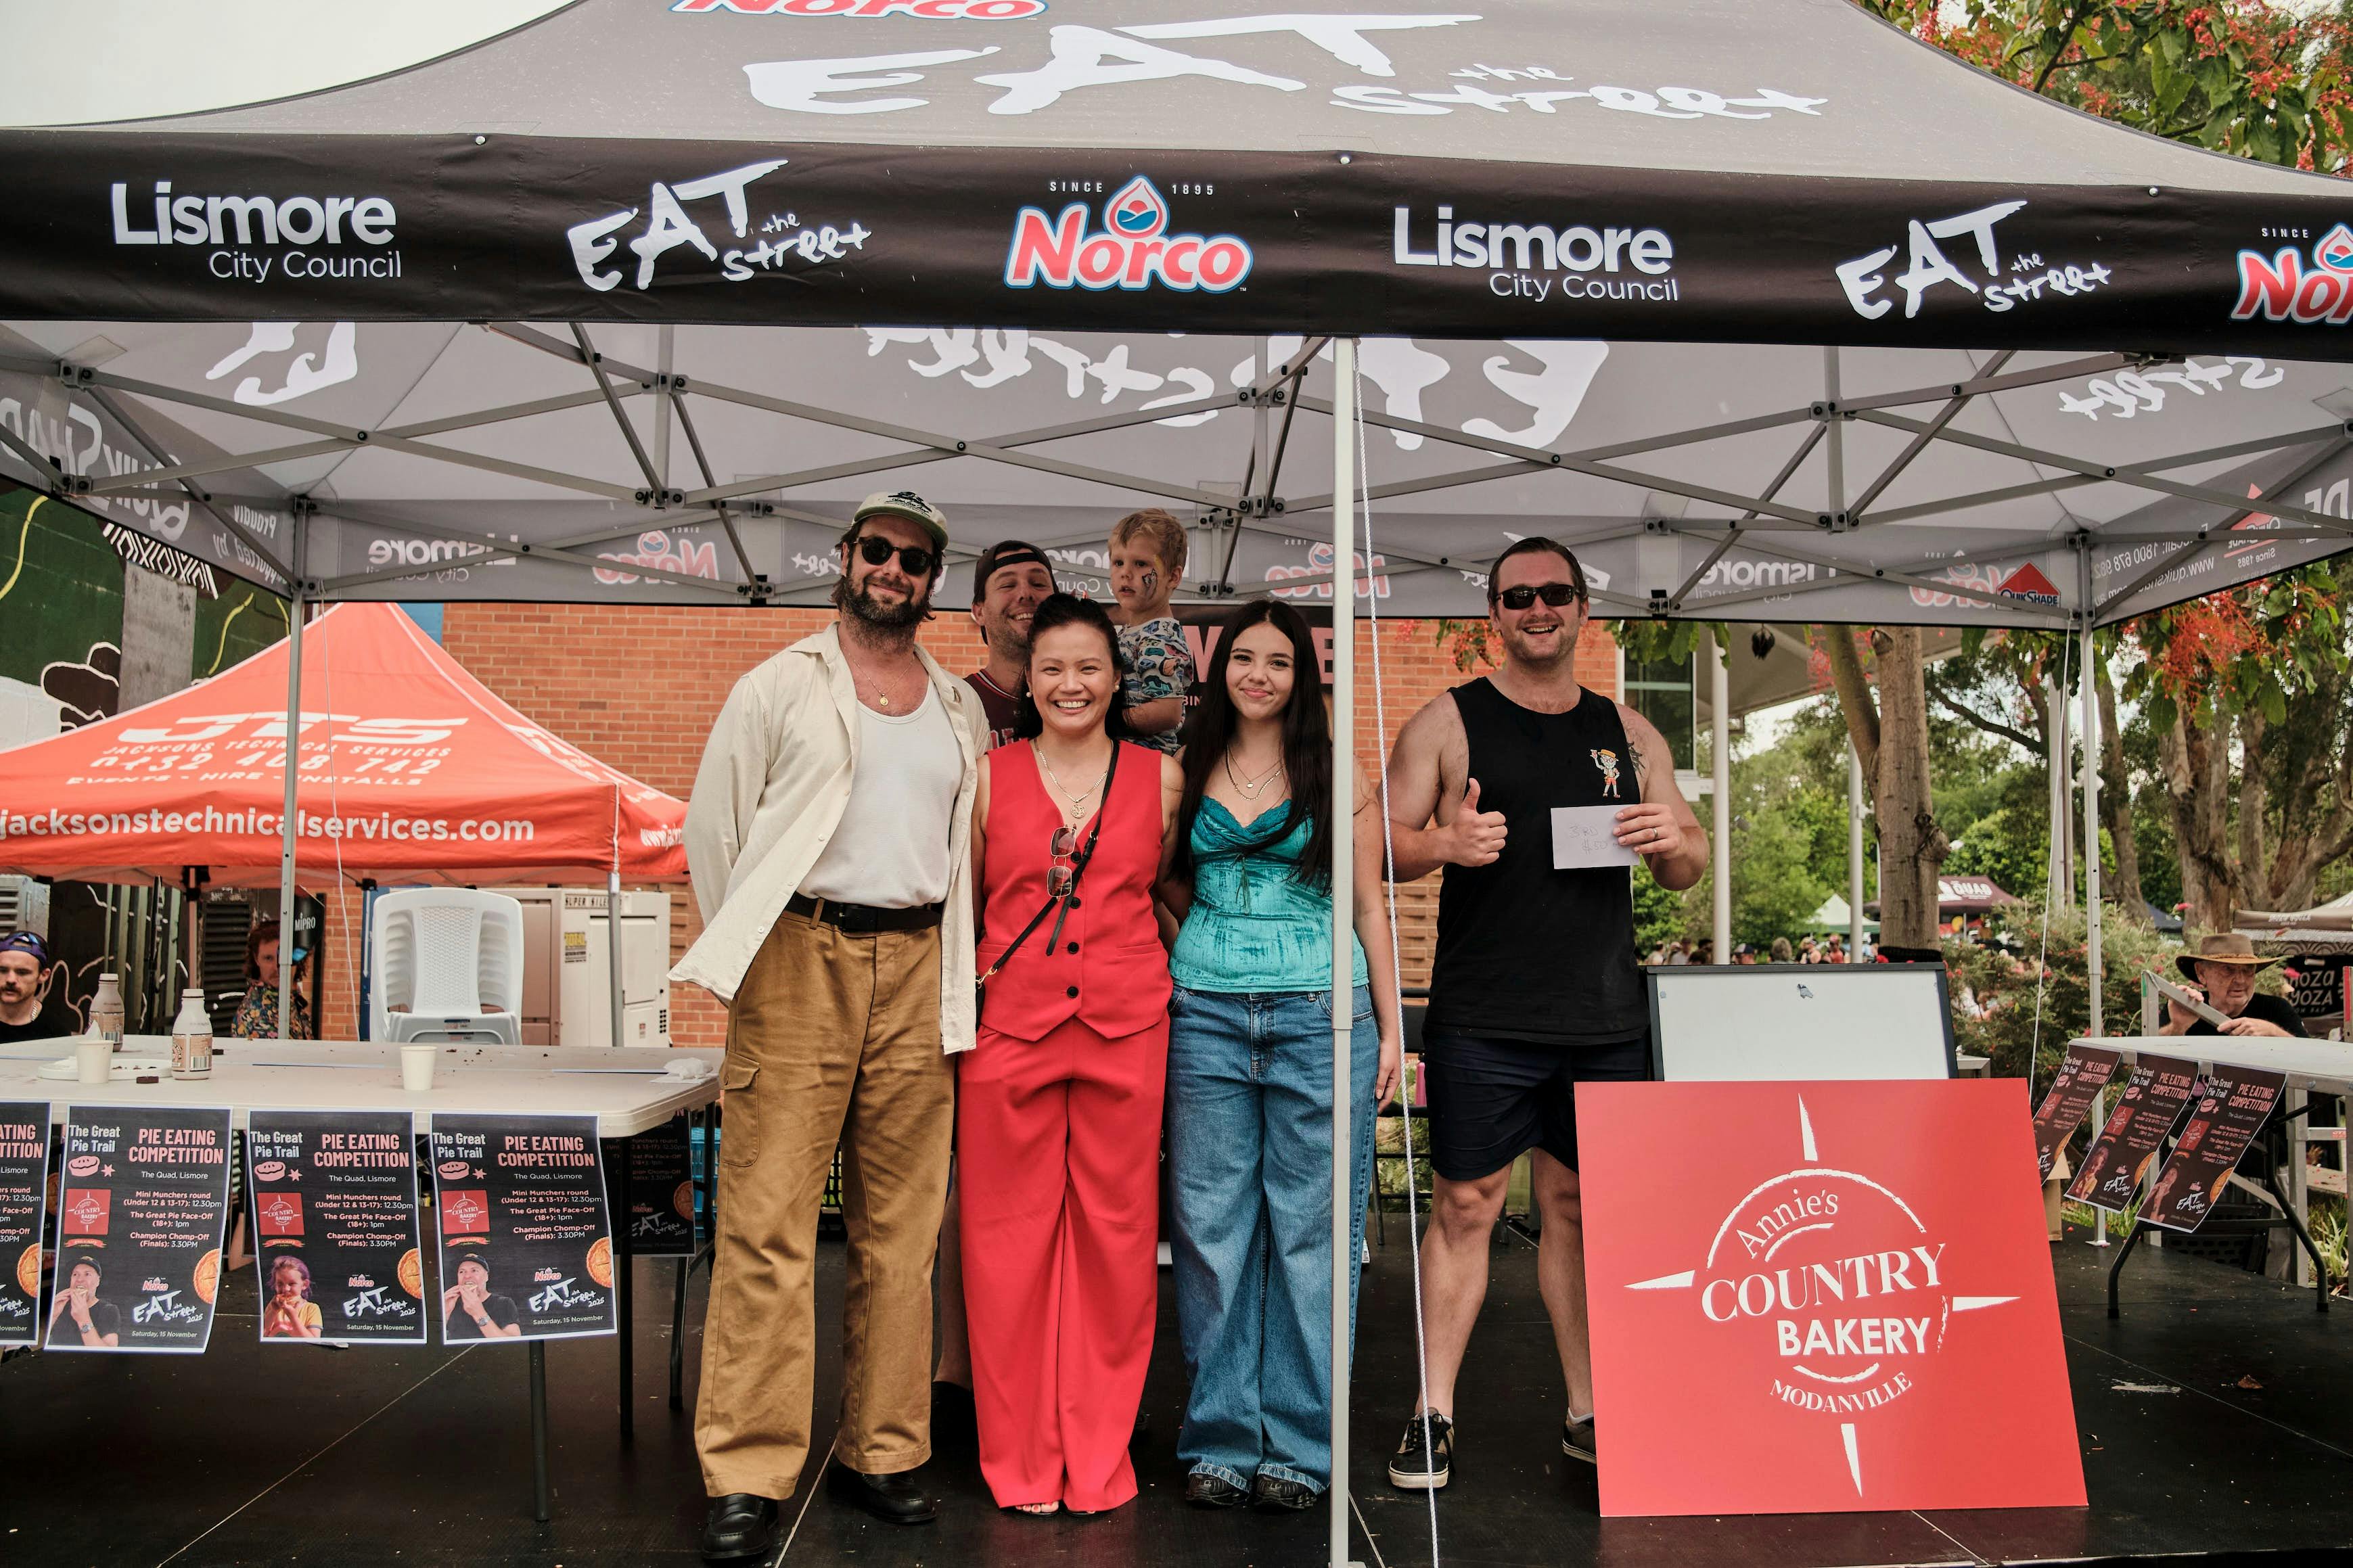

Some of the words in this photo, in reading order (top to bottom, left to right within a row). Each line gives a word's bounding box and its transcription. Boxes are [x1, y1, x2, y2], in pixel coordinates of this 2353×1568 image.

[741, 14, 1484, 115] EAT
[1448, 63, 1574, 81] the
[1329, 84, 1828, 120] street
[1049, 181, 1103, 193] SINCE
[1172, 183, 1214, 196] 1895
[111, 180, 396, 245] Lismore
[567, 159, 788, 291] EAT
[761, 212, 801, 234] the
[1394, 205, 1673, 274] Lismore
[2261, 227, 2309, 238] SINCE
[723, 225, 871, 281] street
[1005, 203, 1253, 292] Norco
[209, 251, 272, 283] City
[282, 250, 401, 279] Council
[1835, 201, 2027, 320] EAT
[2011, 252, 2044, 273] the
[1489, 273, 1551, 302] City
[1562, 274, 1678, 302] Council
[1984, 263, 2111, 312] street
[118, 712, 468, 744] JTS
[102, 742, 214, 755] JACKSONS
[350, 745, 451, 758] SERVICES
[355, 758, 442, 775] 742
[200, 772, 264, 780] HIRE
[295, 913, 315, 931] MIPRO
[2160, 1073, 2172, 1084] PIE
[2172, 1075, 2191, 1087] EATING
[2220, 1079, 2232, 1088] Great
[2151, 1084, 2190, 1099] COMPETITION
[2207, 1088, 2216, 1096] Pie
[2238, 1084, 2250, 1095] PIE
[2252, 1086, 2274, 1099] EATING
[2229, 1096, 2273, 1111] COMPETITION
[68, 1125, 88, 1137] The
[91, 1125, 120, 1138] Great
[139, 1128, 162, 1145] PIE
[165, 1129, 216, 1145] EATING
[250, 1131, 271, 1143] The
[273, 1131, 303, 1143] Great
[433, 1132, 453, 1145] The
[455, 1133, 486, 1145] Great
[71, 1140, 89, 1151] Pie
[92, 1140, 116, 1152] Trail
[321, 1134, 344, 1149] PIE
[348, 1134, 400, 1150] EATING
[505, 1136, 528, 1151] PIE
[532, 1136, 584, 1151] EATING
[129, 1147, 224, 1163] COMPETITION
[255, 1146, 272, 1157] Pie
[274, 1146, 300, 1158] Trail
[314, 1152, 409, 1168] COMPETITION
[438, 1147, 455, 1157] Pie
[457, 1147, 483, 1158] Trail
[497, 1153, 595, 1167] COMPETITION
[153, 1191, 187, 1199] Munchers
[2176, 1192, 2203, 1210] EAT
[192, 1200, 222, 1208] 12.30pm
[513, 1226, 552, 1235] Champion
[553, 1224, 595, 1232] Chomp-Off
[1737, 1189, 1839, 1258] Annie's
[534, 1271, 562, 1282] Norco
[1701, 1243, 1946, 1322] COUNTRY
[343, 1286, 389, 1316] EAT
[528, 1277, 576, 1312] EAT
[563, 1290, 596, 1308] street
[588, 1297, 604, 1308] 2025
[133, 1290, 182, 1322] EAT
[164, 1306, 197, 1321] street
[186, 1314, 203, 1324] 2025
[572, 1315, 603, 1323] November
[1777, 1317, 1931, 1357] BAKERY
[1770, 1371, 1912, 1413] MODANVILLE
